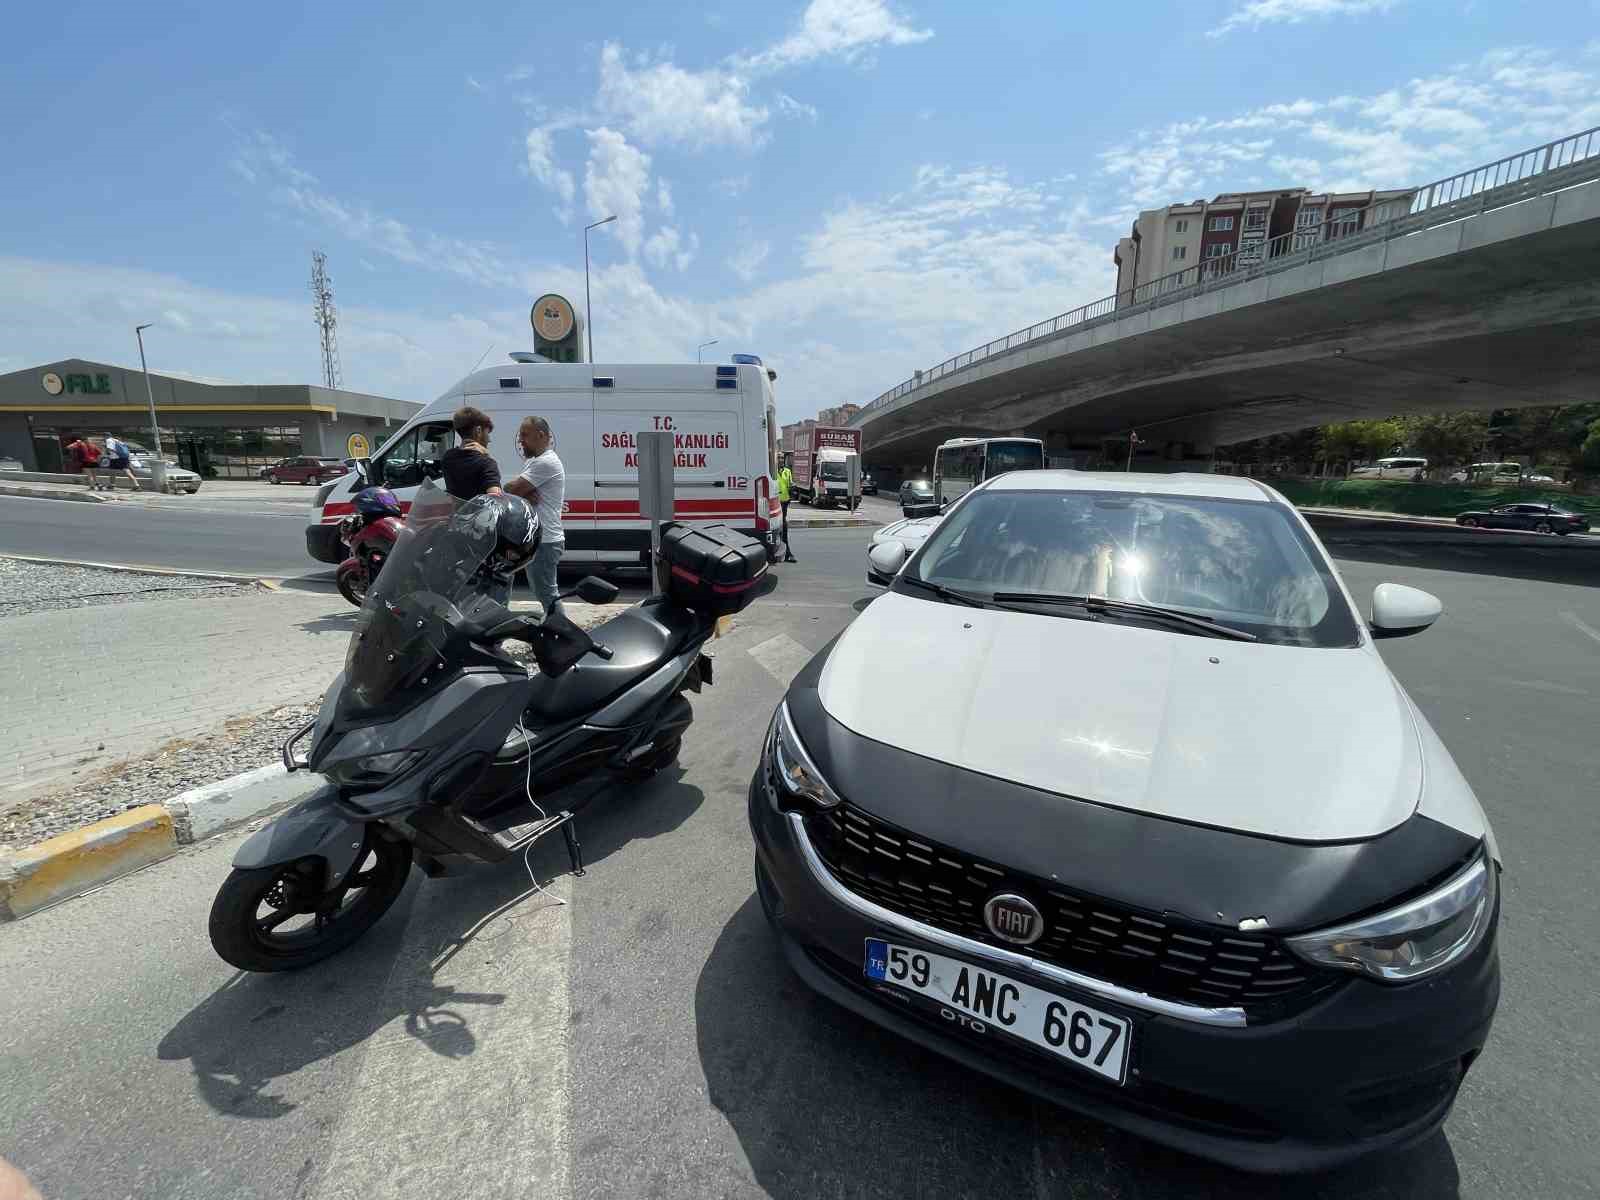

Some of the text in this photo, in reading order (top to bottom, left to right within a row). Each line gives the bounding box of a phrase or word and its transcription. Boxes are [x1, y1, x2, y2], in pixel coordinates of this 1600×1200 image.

[653, 416, 677, 430] T.C.
[602, 432, 637, 448] SAĞL
[727, 476, 748, 488] 112
[999, 907, 1032, 936] FIAT
[871, 948, 1122, 1067] TR 59 ANC 667
[940, 1007, 986, 1034] OTO
